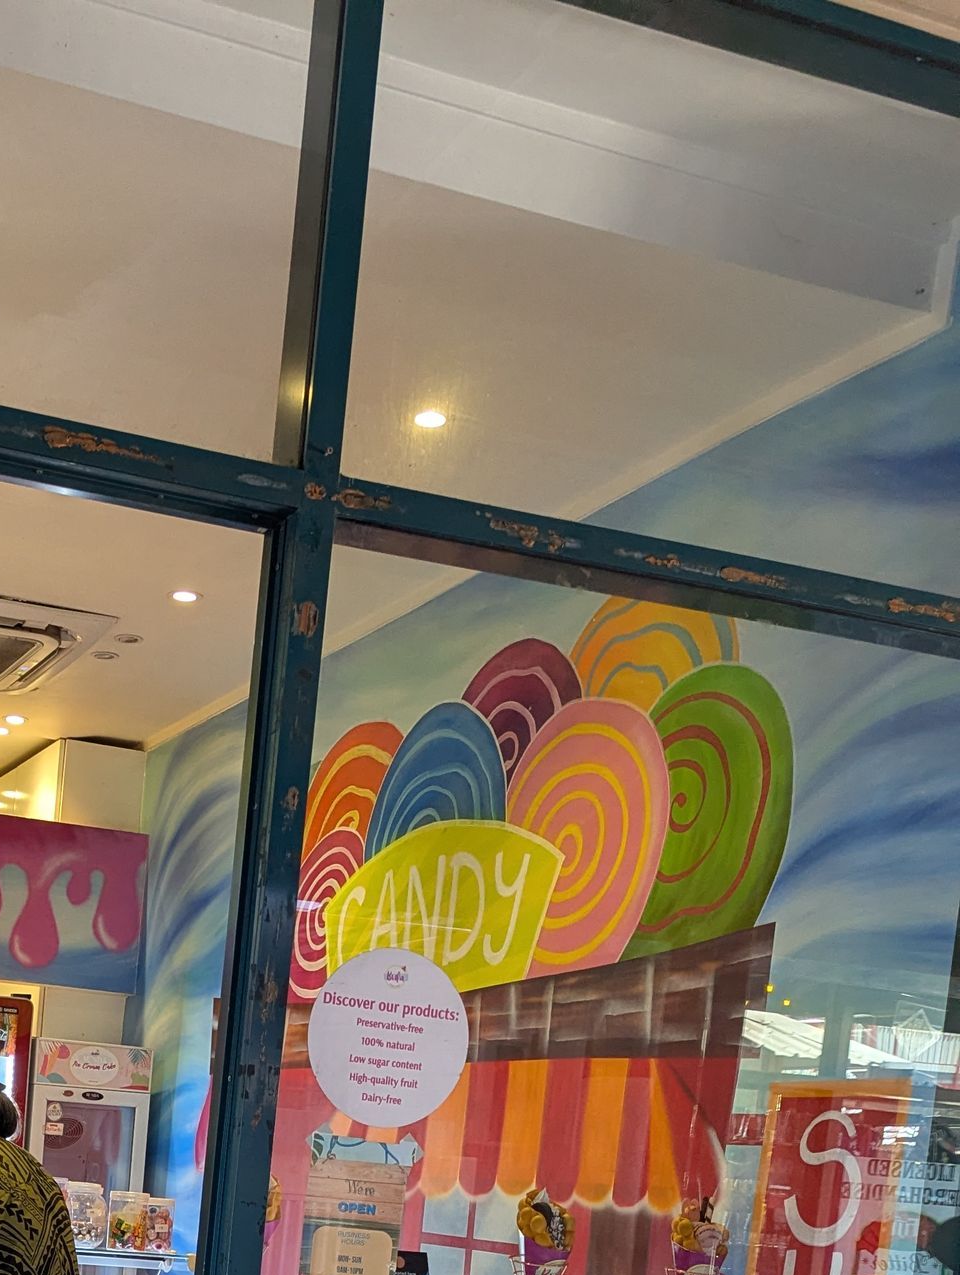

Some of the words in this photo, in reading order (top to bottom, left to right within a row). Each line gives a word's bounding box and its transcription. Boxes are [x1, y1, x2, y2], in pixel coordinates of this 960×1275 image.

[337, 851, 531, 966] CANDY
[322, 991, 376, 1010] Discover
[378, 1000, 400, 1013] our
[401, 1004, 460, 1022] products:
[356, 1017, 424, 1034] Preservative-free
[360, 1036, 385, 1048] 100%
[385, 1040, 416, 1052] natural
[349, 1054, 366, 1065] Low
[367, 1057, 390, 1069] sugar
[391, 1059, 422, 1071] content
[349, 1072, 399, 1089] High-quality
[400, 1077, 418, 1089] fruit
[361, 1092, 402, 1106] Dairy-free
[337, 1200, 377, 1216] OPEN
[337, 1231, 371, 1240] BUSINESS
[340, 1239, 366, 1247] HOURS
